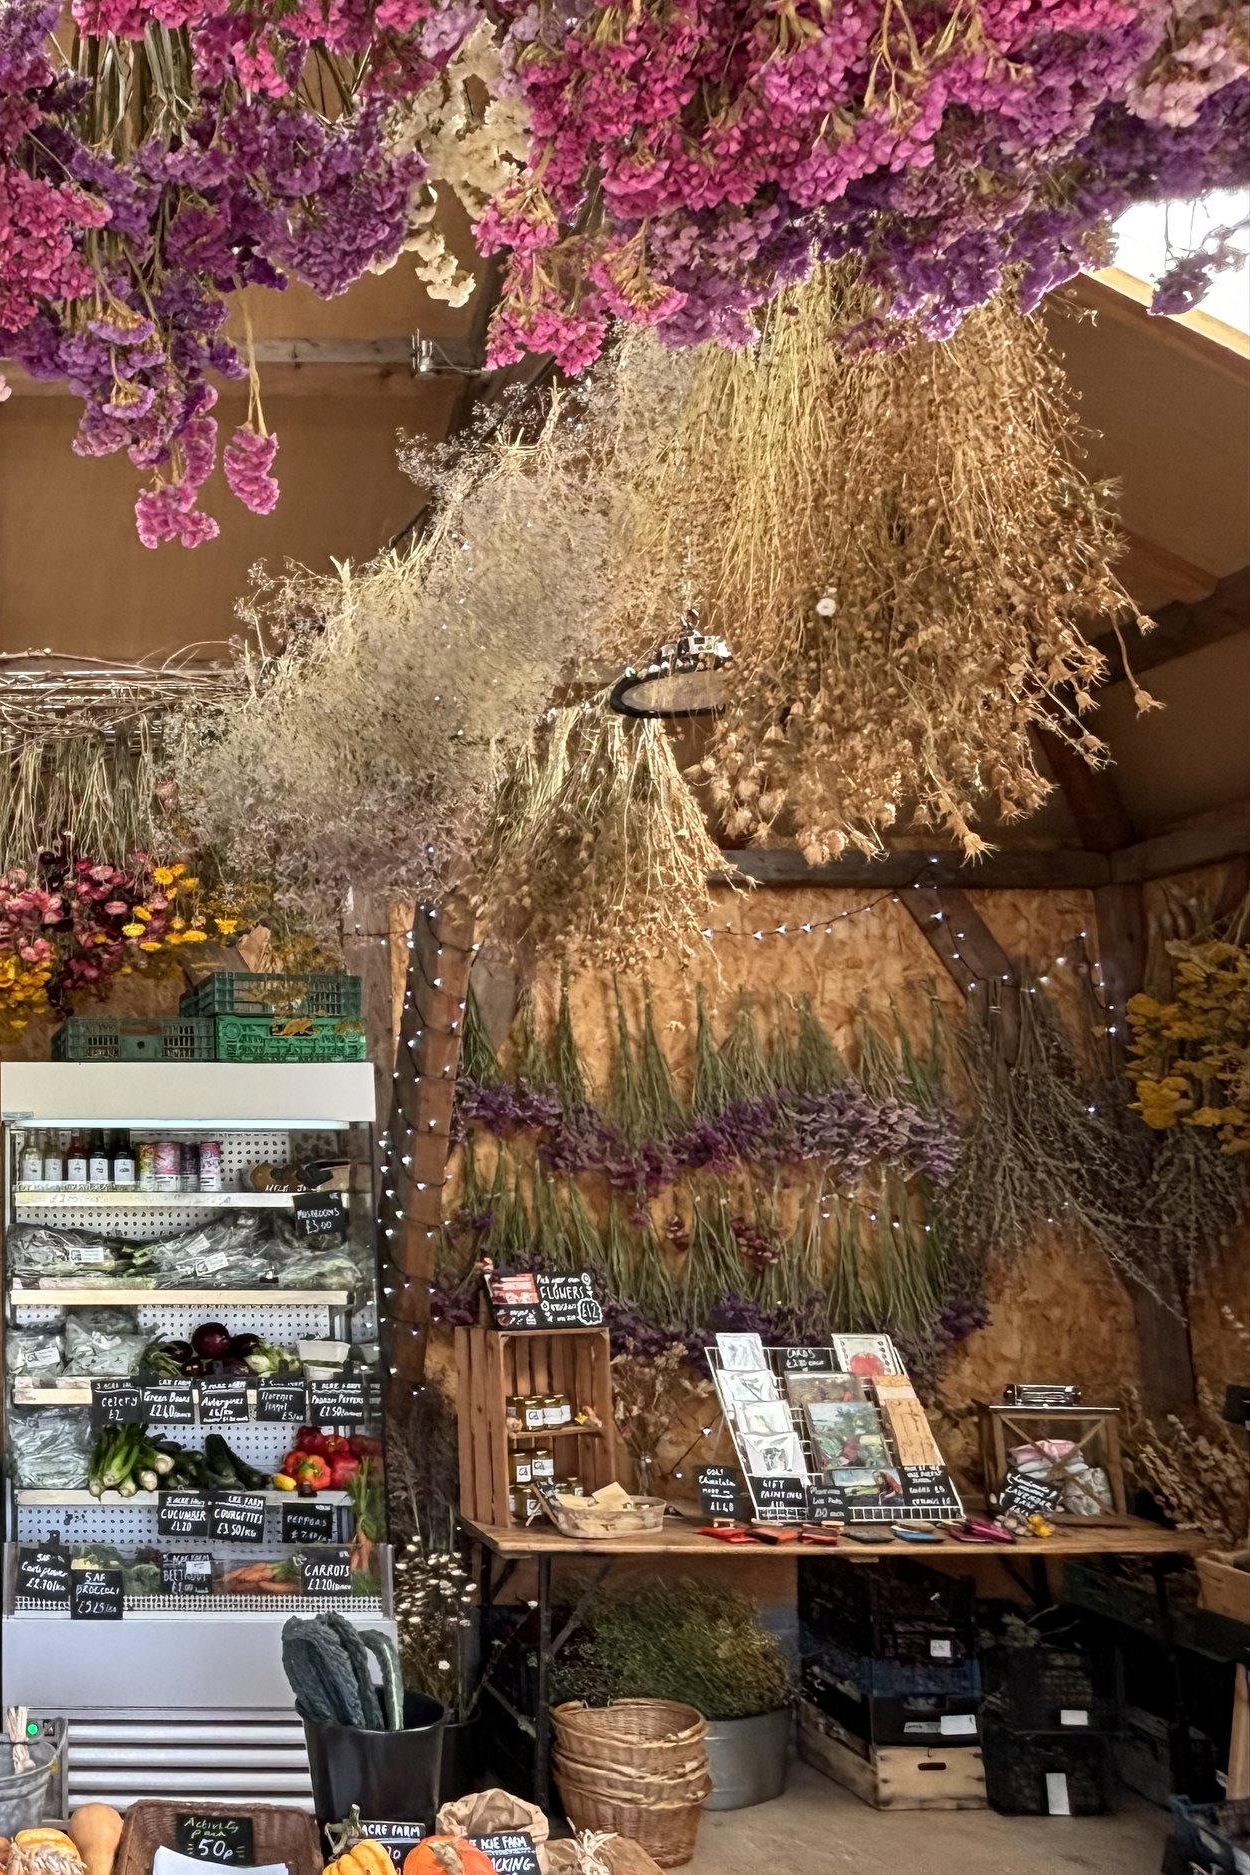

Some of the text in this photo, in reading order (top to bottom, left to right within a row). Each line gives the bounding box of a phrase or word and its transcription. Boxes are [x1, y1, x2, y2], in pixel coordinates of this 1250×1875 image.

[540, 1286, 584, 1300] FLOWERS
[160, 1508, 206, 1521] CUCUMBER
[214, 1508, 263, 1524] COURGETTES
[304, 1564, 350, 1576] CARROTS
[184, 1817, 239, 1834] Activity
[392, 1826, 420, 1837] FARM
[198, 1838, 234, 1860] 50p
[480, 1836, 500, 1850] ACRE
[502, 1836, 528, 1848] FARM
